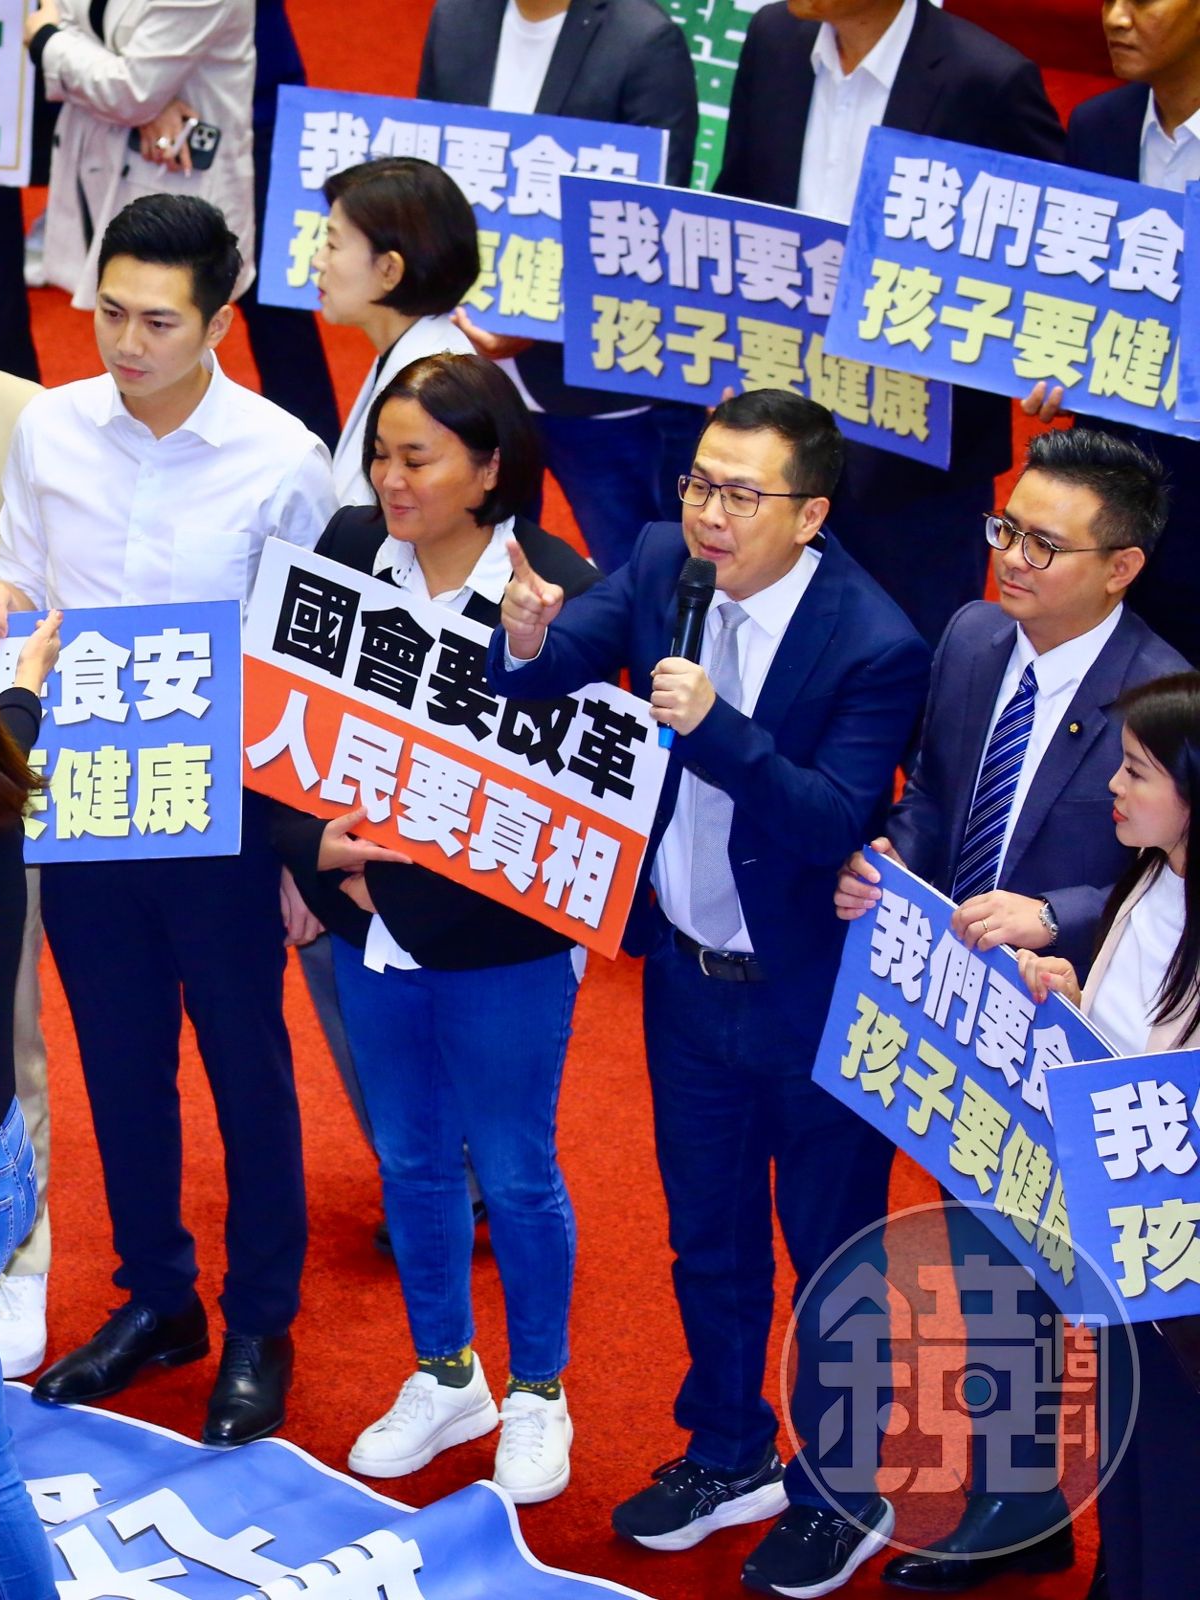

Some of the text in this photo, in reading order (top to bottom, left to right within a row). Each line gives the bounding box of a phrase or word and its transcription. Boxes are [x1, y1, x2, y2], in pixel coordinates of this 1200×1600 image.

[591, 294, 930, 442] 孩子要健康
[858, 258, 1181, 411] 孩子要健
[272, 565, 648, 801] 國會要改革
[246, 689, 622, 930] 人民要真相
[1090, 1080, 1200, 1180] 我
